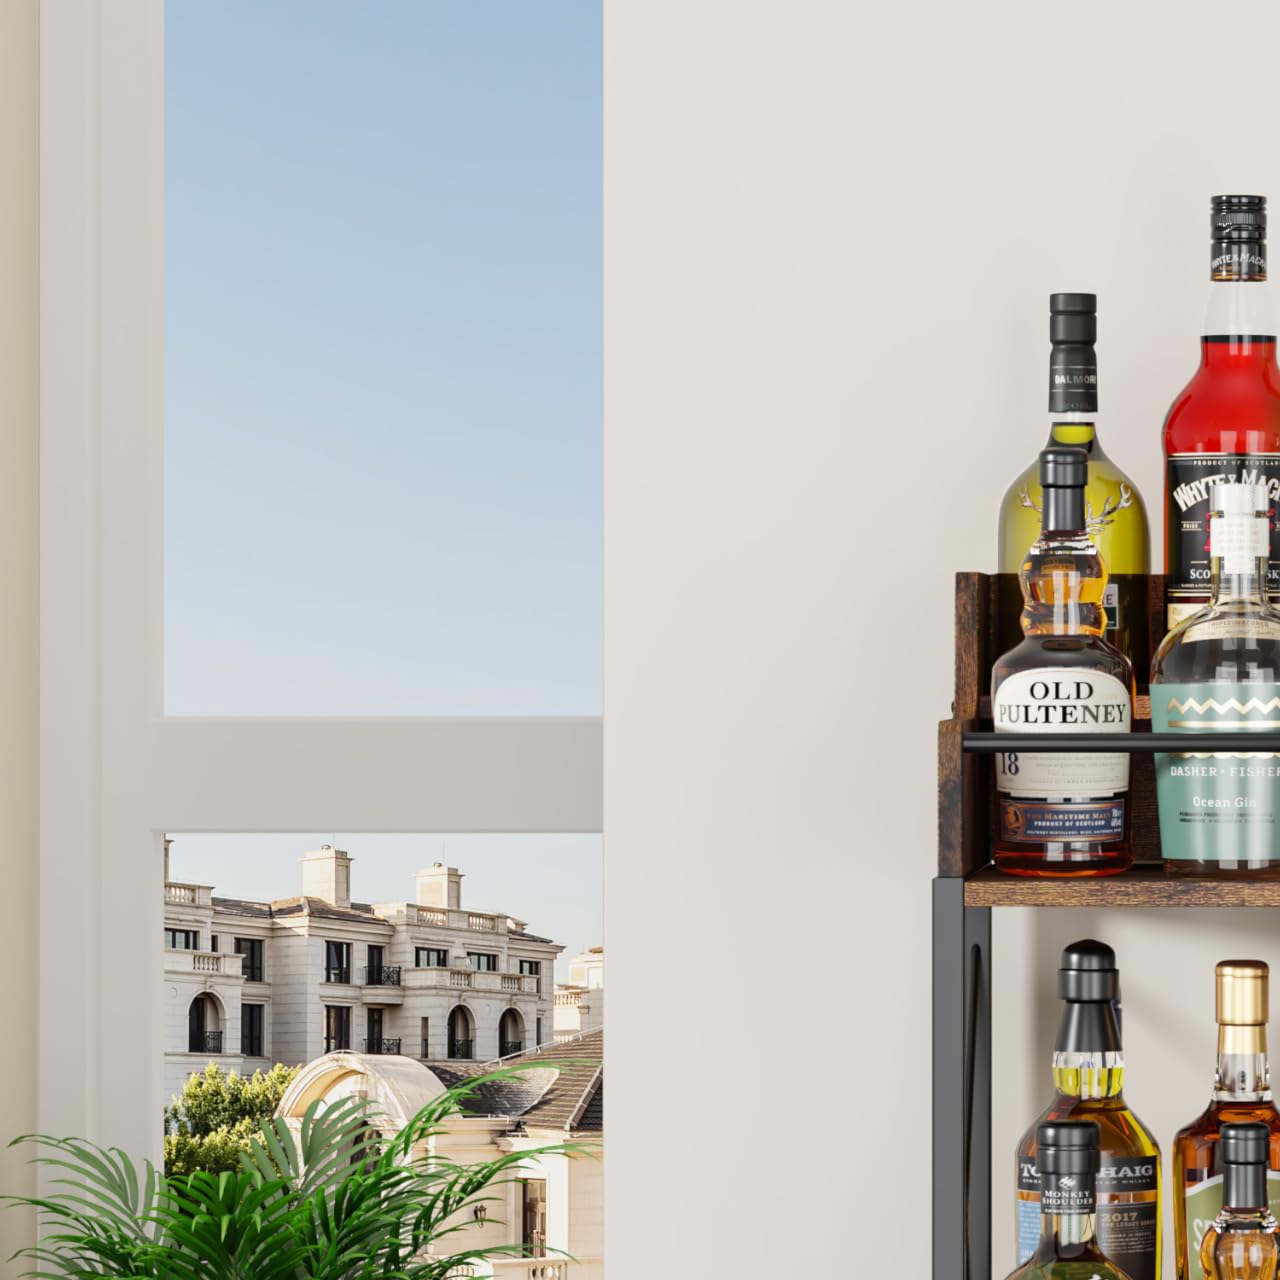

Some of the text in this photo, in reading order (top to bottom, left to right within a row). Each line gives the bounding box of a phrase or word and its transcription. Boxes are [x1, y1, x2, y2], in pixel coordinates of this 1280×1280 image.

[1029, 681, 1094, 701] OLD
[999, 703, 1126, 724] PULTENEY
[1001, 752, 1020, 776] 18
[1170, 766, 1218, 777] DASHER
[1193, 796, 1257, 808] Ocean Gin
[1045, 1190, 1090, 1198] MONKEY
